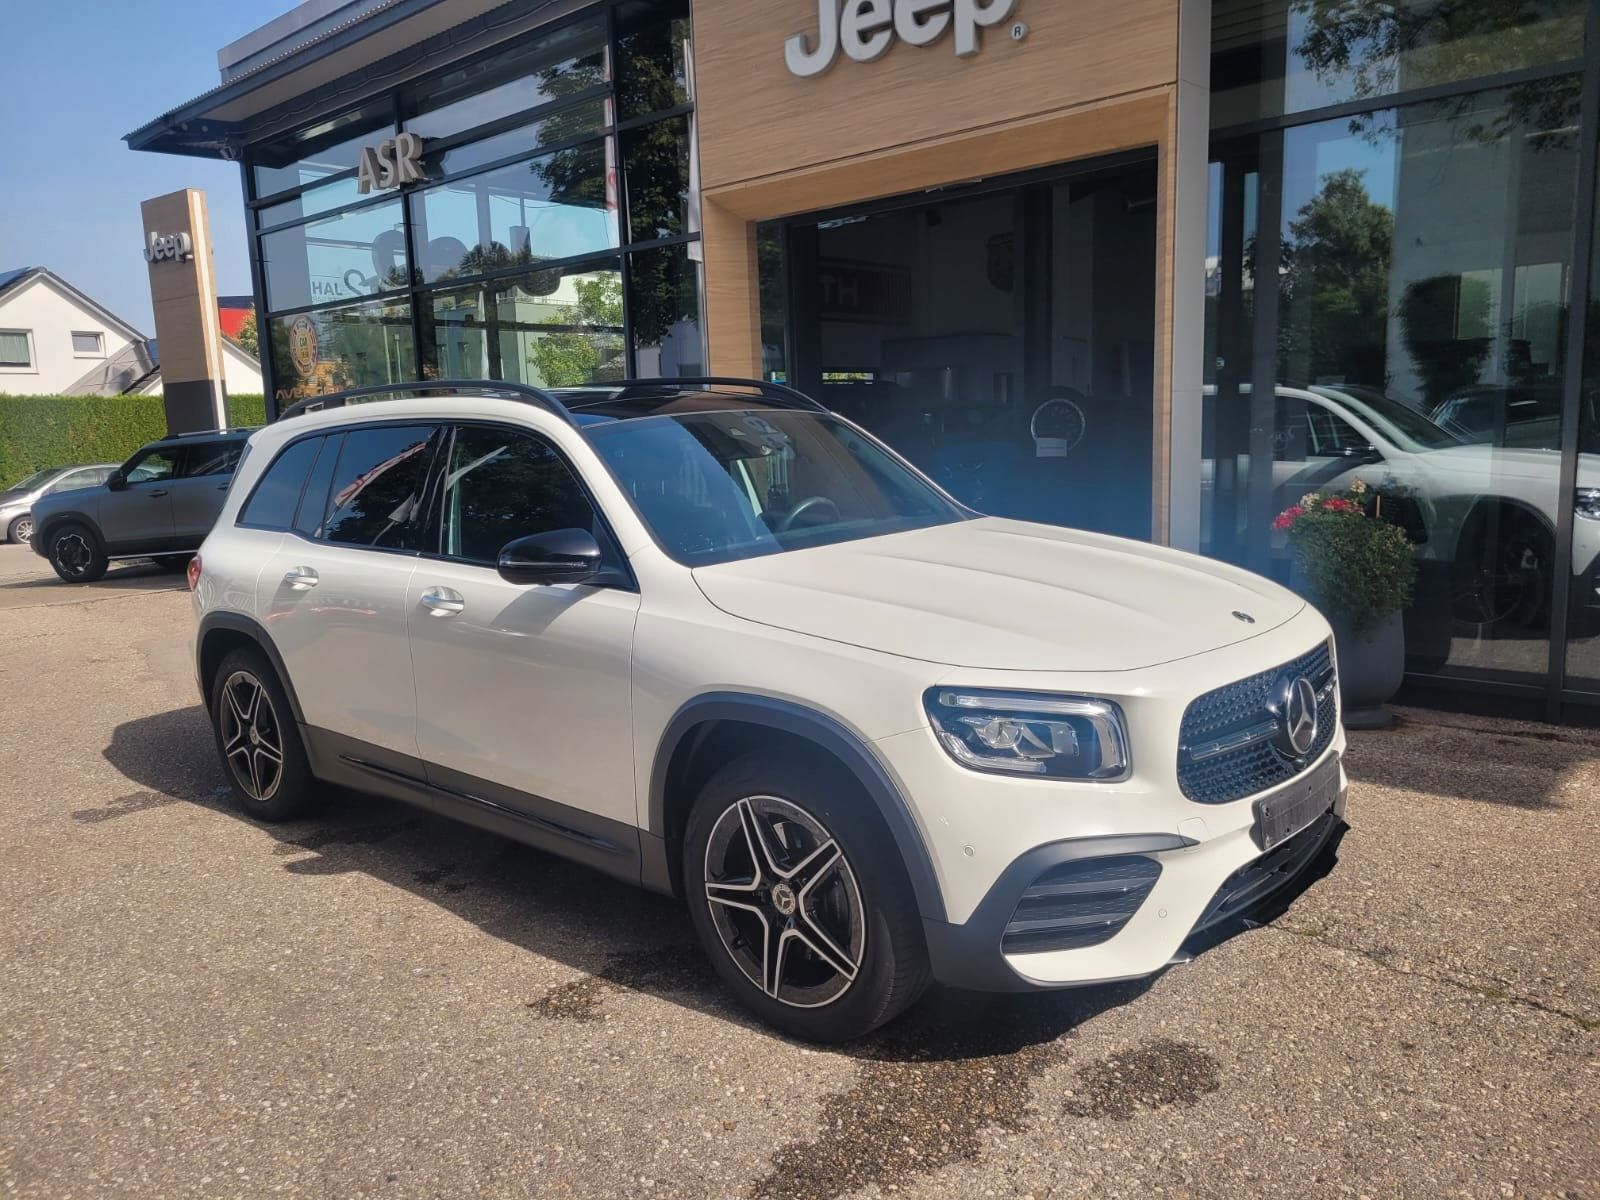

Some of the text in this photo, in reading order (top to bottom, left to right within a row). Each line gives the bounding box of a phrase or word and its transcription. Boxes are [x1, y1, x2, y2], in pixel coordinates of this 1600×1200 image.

[785, 0, 1013, 78] Jeep
[358, 132, 424, 194] ASR
[143, 231, 190, 262] Jeep
